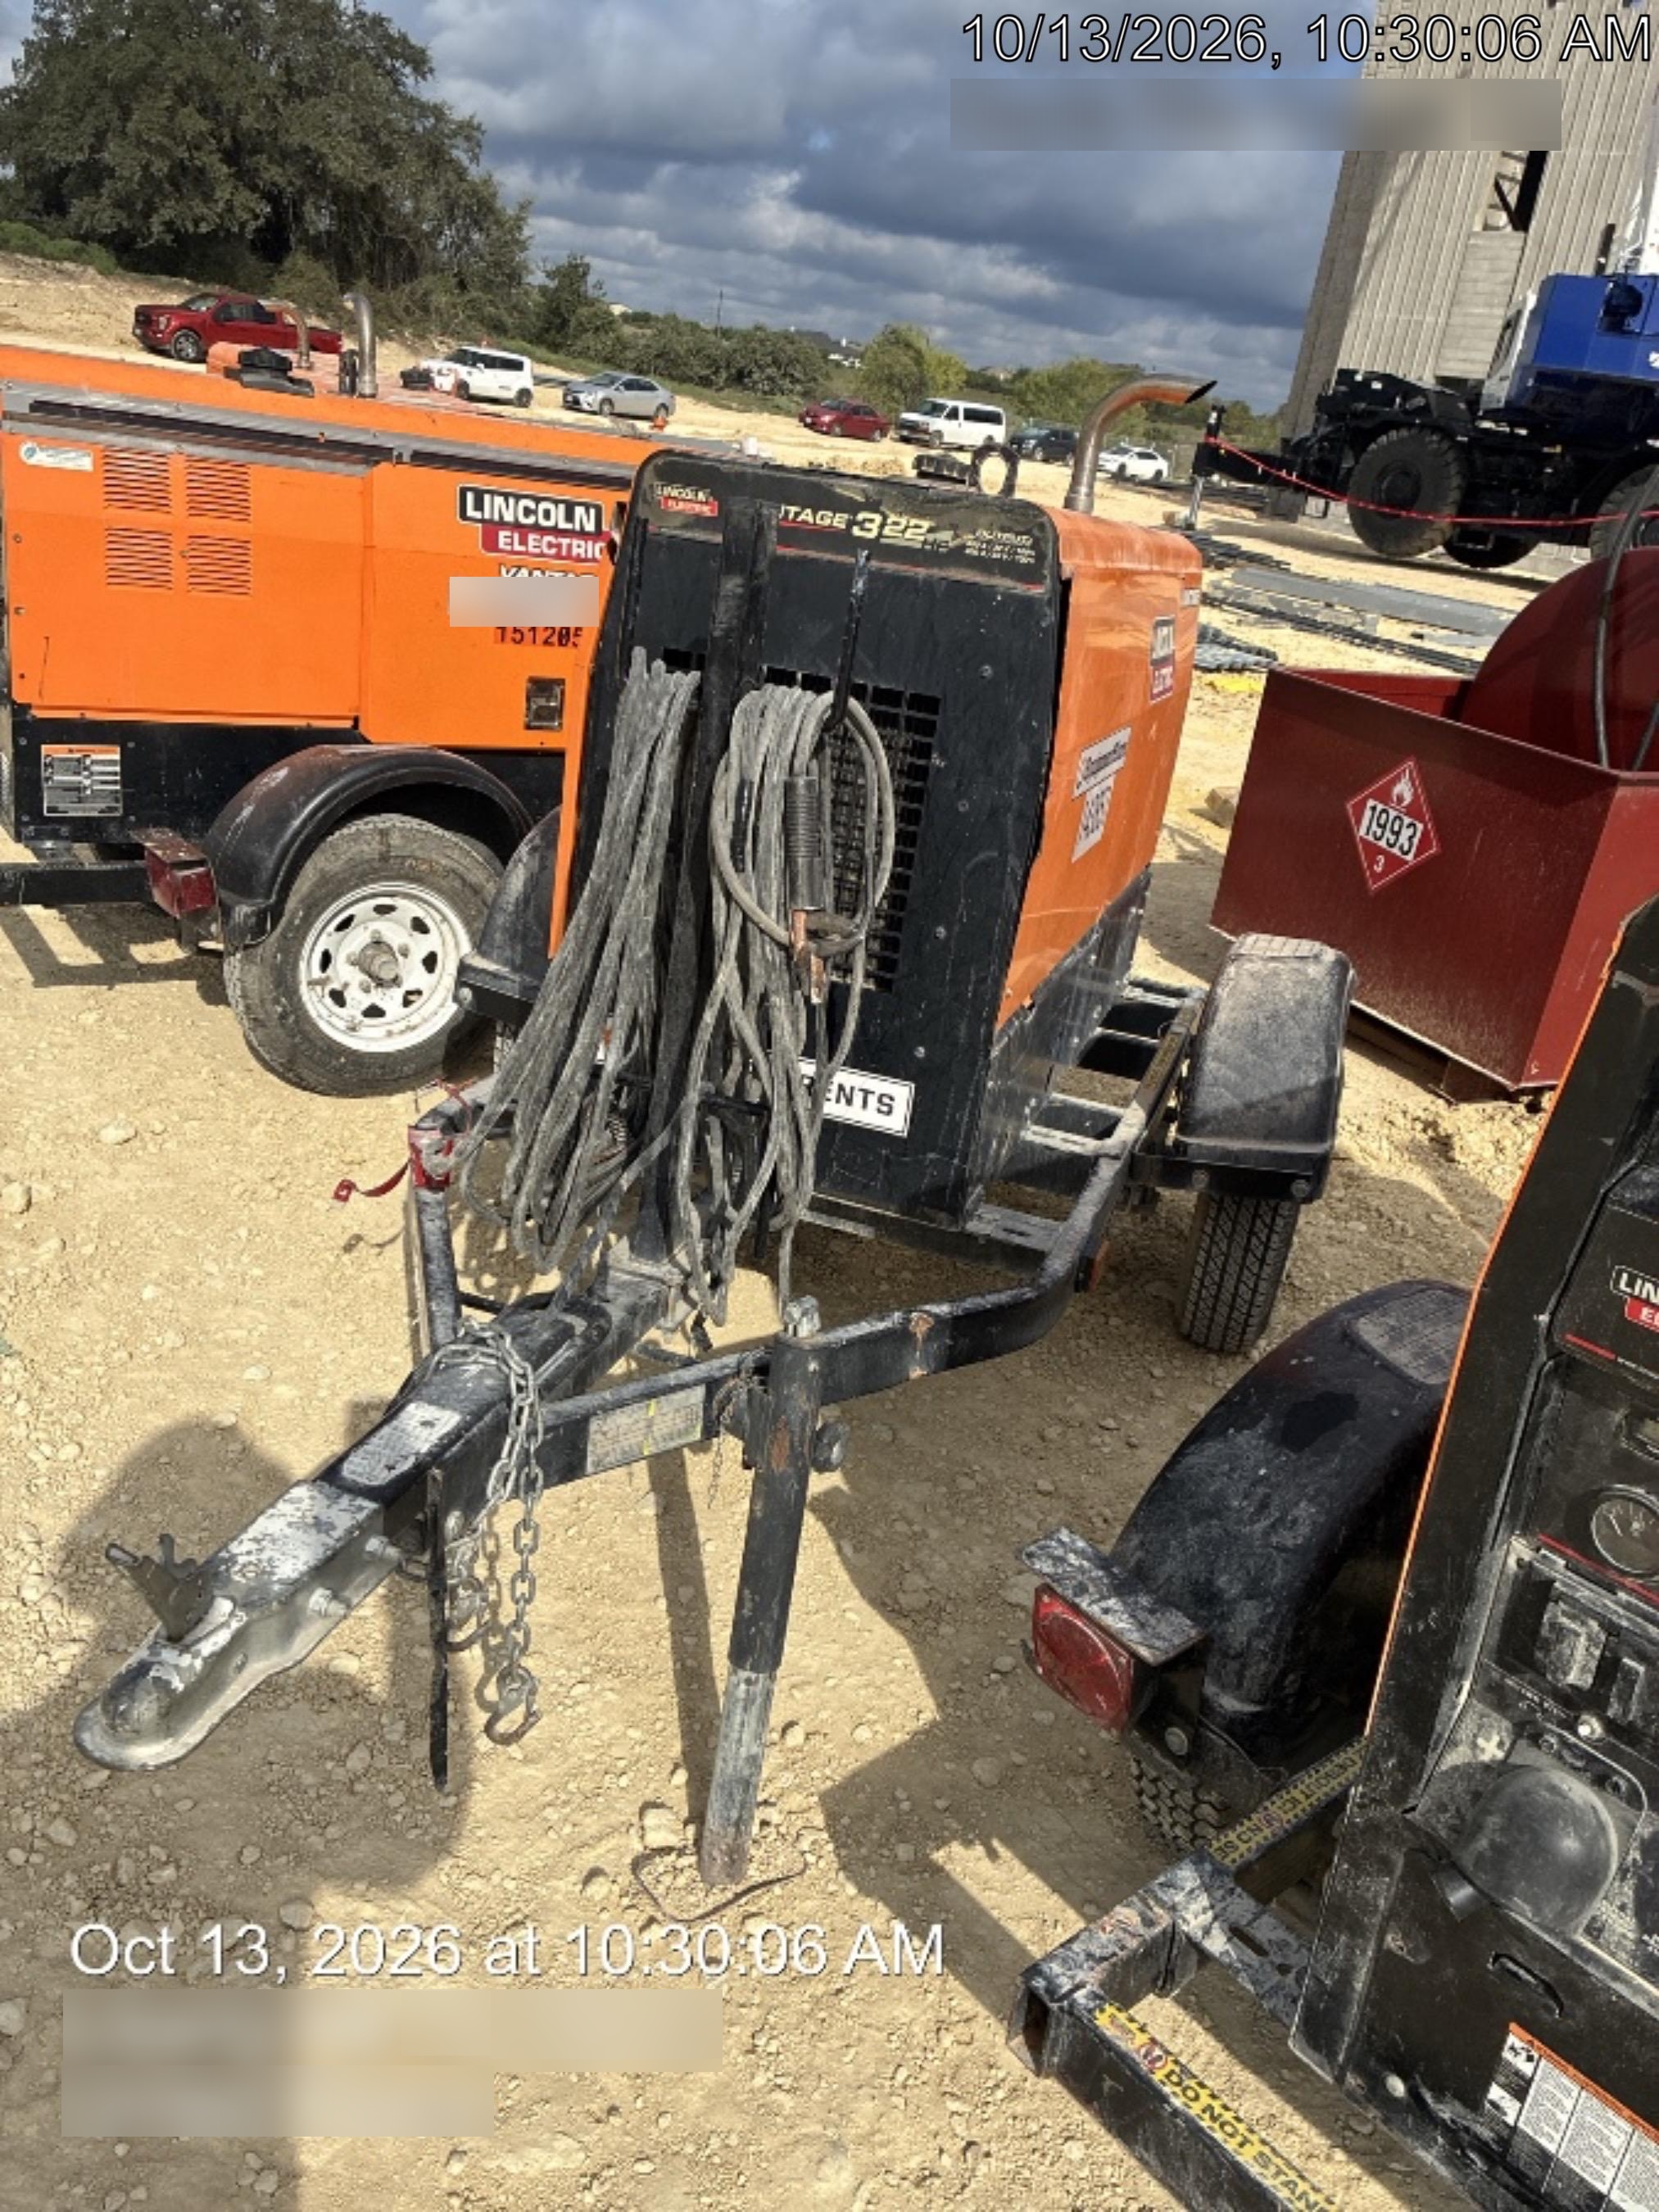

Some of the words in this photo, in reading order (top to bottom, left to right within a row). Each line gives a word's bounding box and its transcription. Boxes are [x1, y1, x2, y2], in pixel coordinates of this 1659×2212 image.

[465, 491, 596, 533] LINCOLN
[853, 510, 934, 542] 322
[1364, 804, 1417, 856] 1993
[1373, 854, 1385, 873] 3
[1165, 2067, 1201, 2103] DO
[1201, 2102, 1254, 2150] NOT
[1253, 2151, 1330, 2212] STAN
